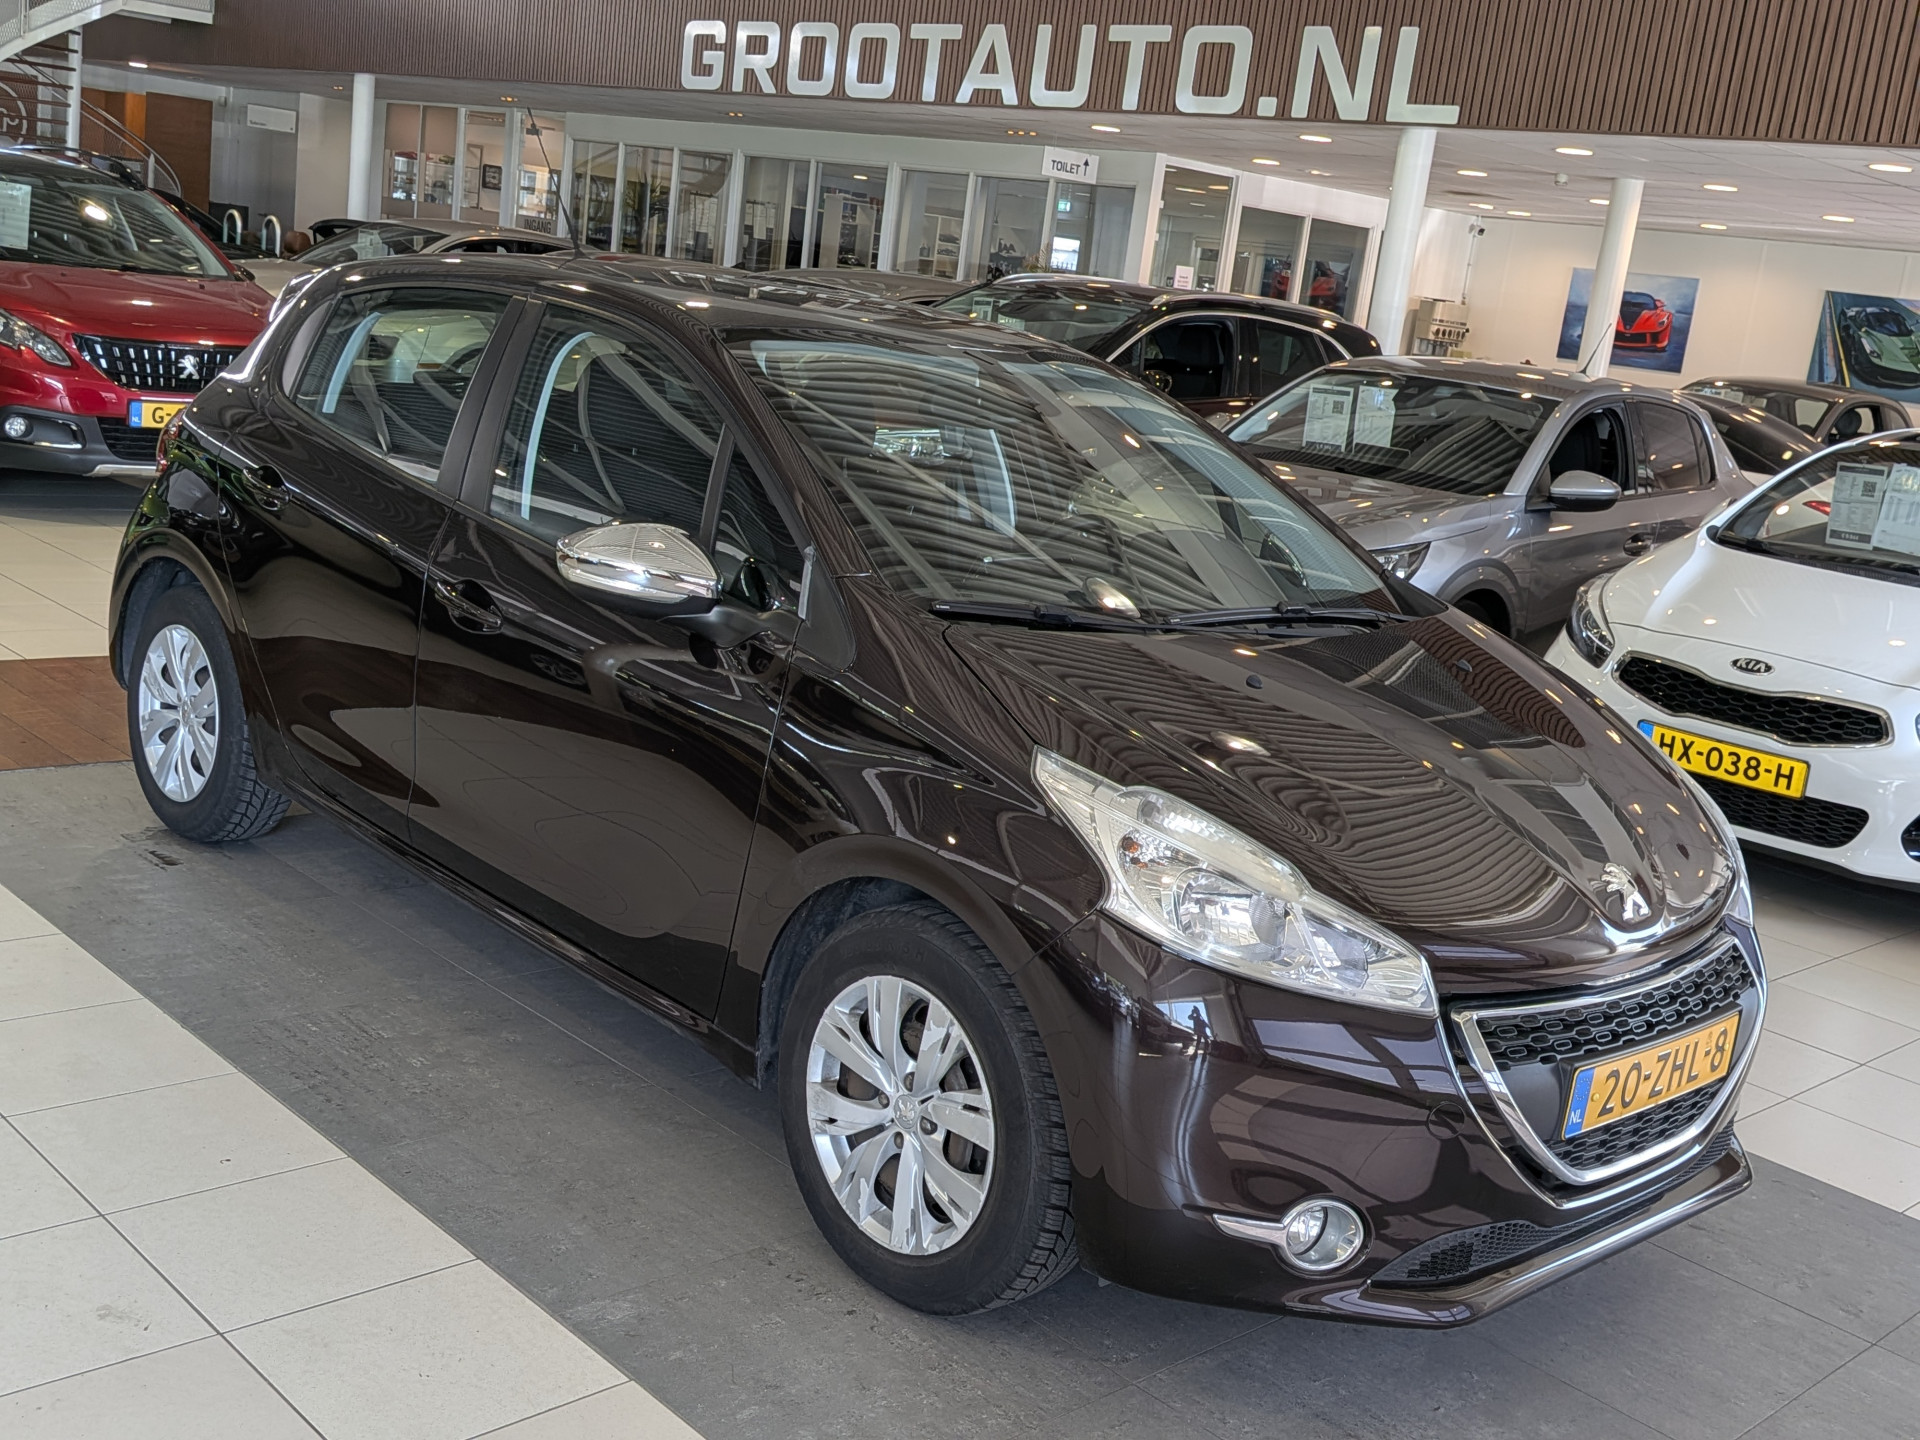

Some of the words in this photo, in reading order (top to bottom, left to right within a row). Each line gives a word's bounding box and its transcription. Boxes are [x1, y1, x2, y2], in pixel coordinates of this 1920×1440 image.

[681, 20, 1460, 125] GROOTAUTO.NL
[1051, 159, 1081, 175] TOILET
[524, 218, 551, 234] INGANG
[1736, 657, 1767, 673] KIA
[1658, 732, 1795, 791] HX-038-H
[1597, 1027, 1728, 1119] 20-ZHL-8
[1569, 1109, 1582, 1125] NL
